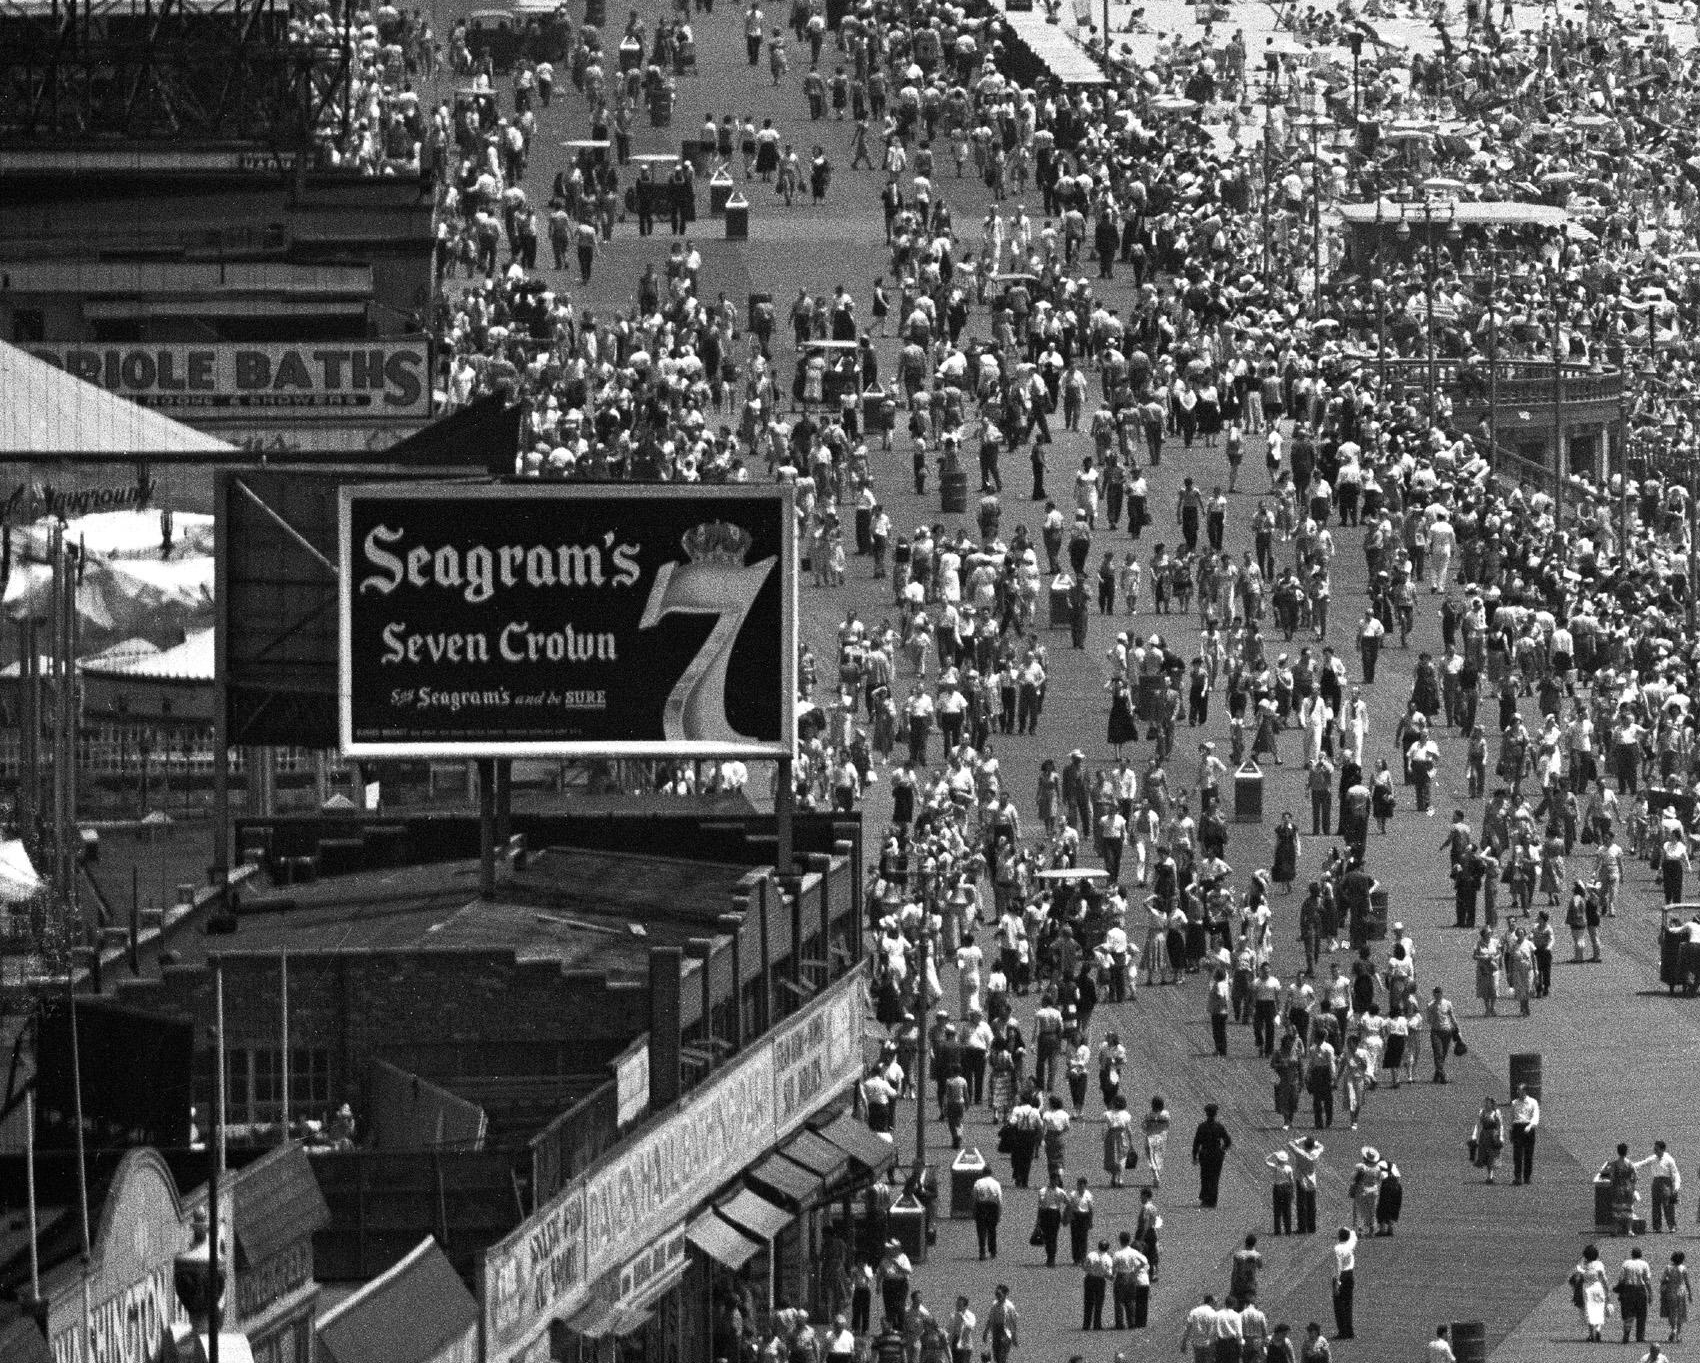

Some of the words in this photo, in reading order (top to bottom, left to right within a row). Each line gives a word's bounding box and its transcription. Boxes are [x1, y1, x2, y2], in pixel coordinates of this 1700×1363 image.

[236, 348, 422, 408] BATHS
[360, 524, 641, 603] Seagram's
[382, 622, 488, 664] Seven
[499, 622, 618, 663] Crown
[640, 555, 779, 741] 7
[417, 686, 511, 713] Seagram's
[565, 690, 606, 709] SURE
